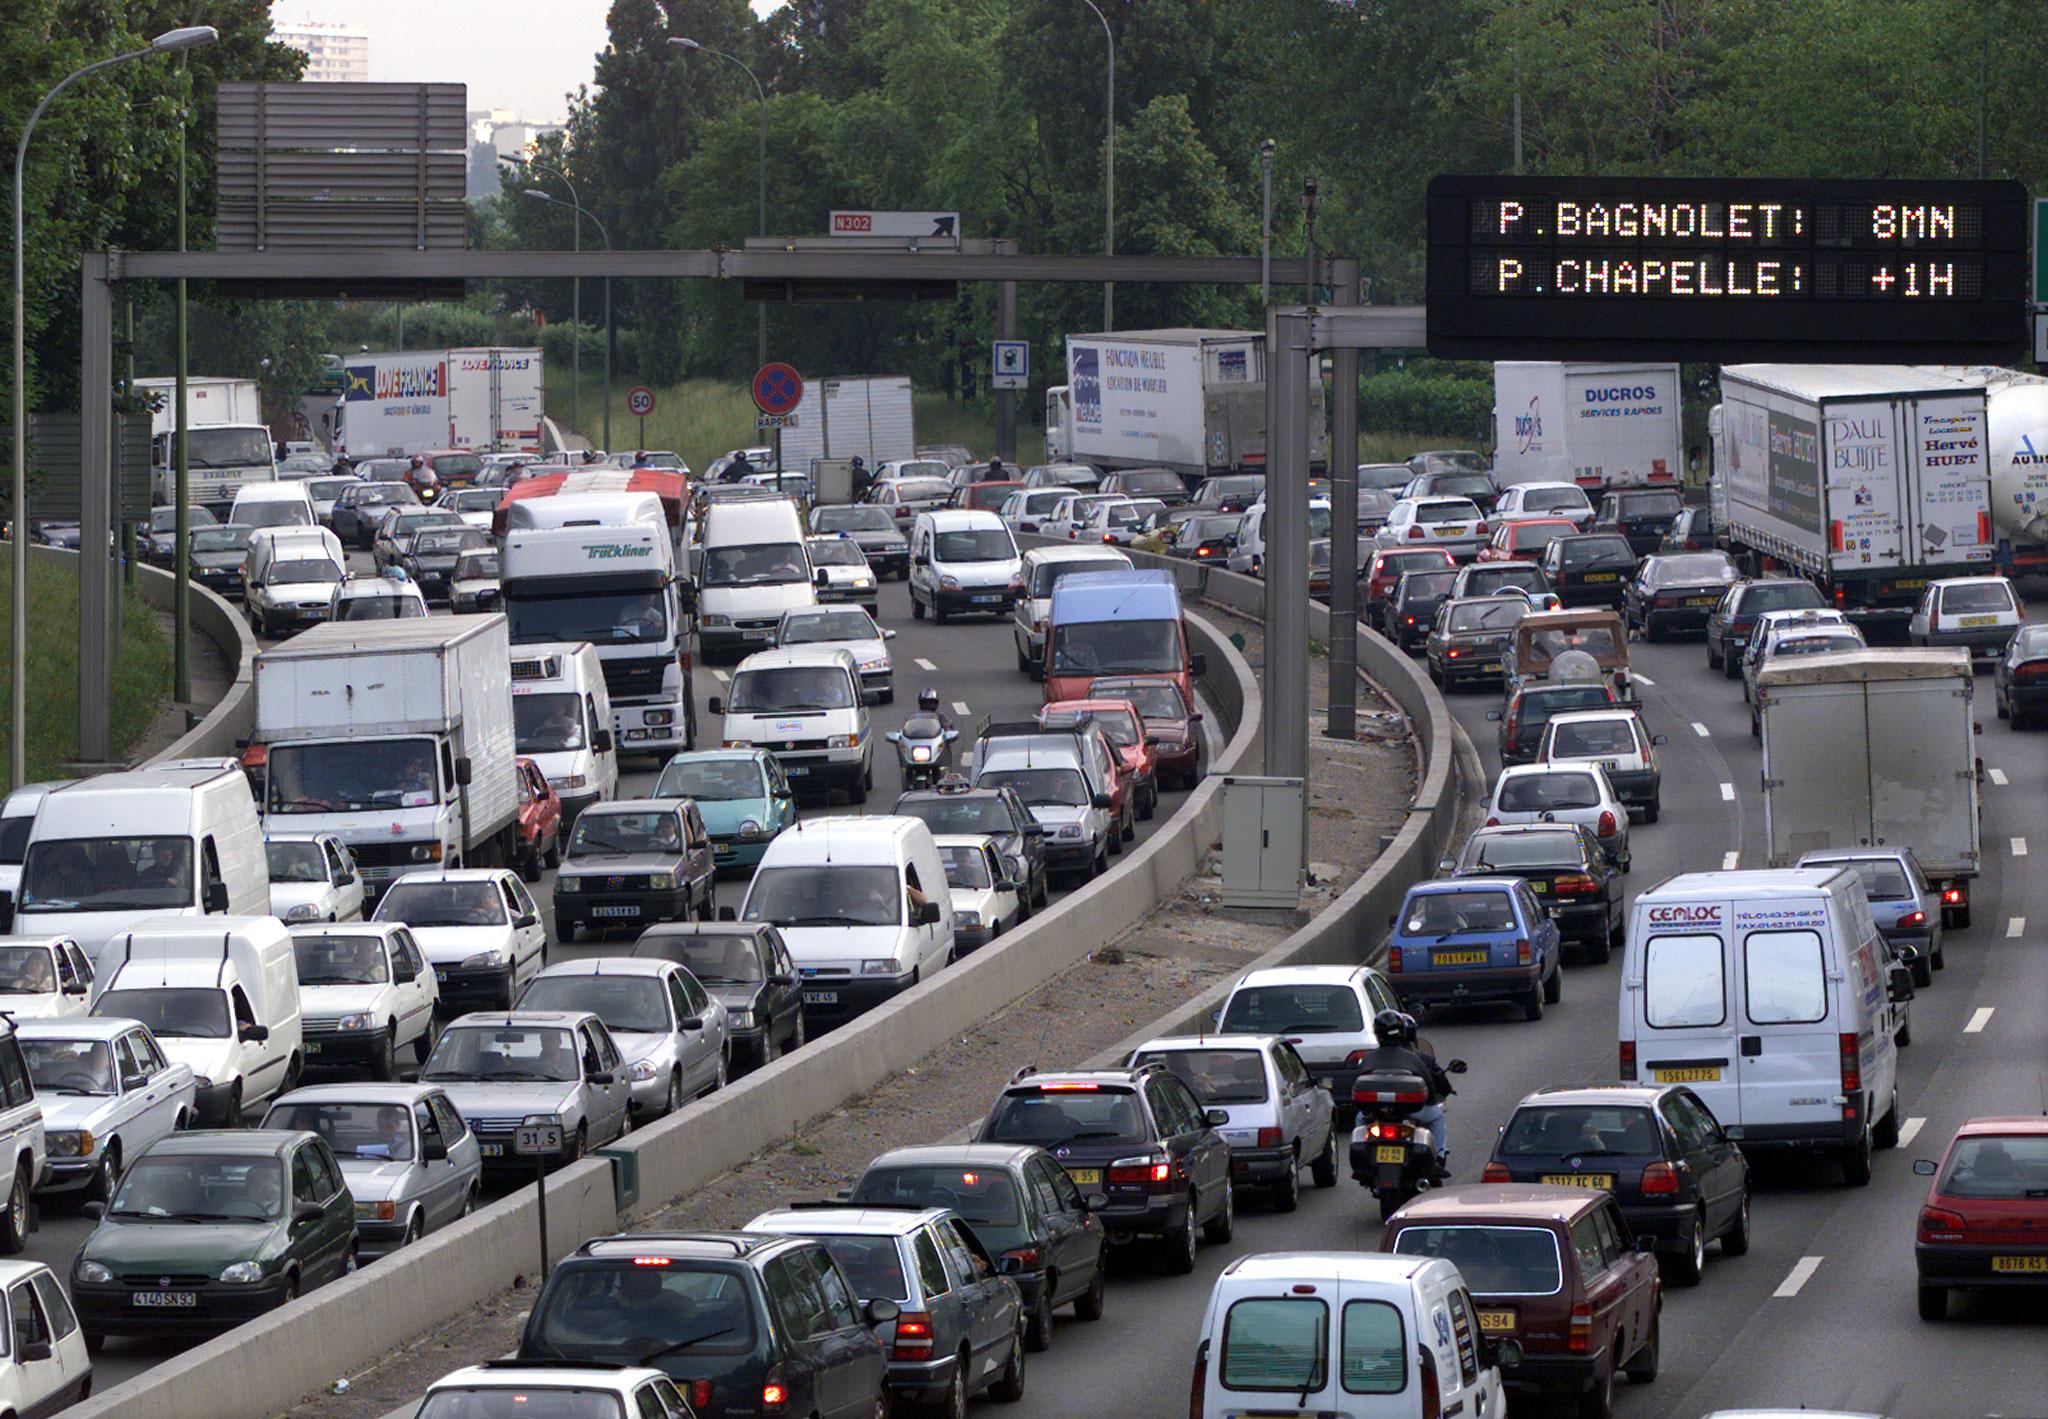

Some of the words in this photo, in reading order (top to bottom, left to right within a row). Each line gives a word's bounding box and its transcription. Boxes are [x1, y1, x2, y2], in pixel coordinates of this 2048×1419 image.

[836, 217, 870, 231] N302
[1873, 205, 1954, 238] 8MN
[633, 394, 650, 408] 50
[1585, 386, 1656, 402] DUCROS
[1580, 408, 1622, 419] SERVICES
[1624, 406, 1663, 417] RAPIDES
[757, 417, 796, 428] RAPPEL
[1832, 418, 1888, 447] PAUL
[1924, 436, 1979, 452] Hervé
[1925, 453, 1979, 468] HUET
[582, 543, 654, 560] Truckliner
